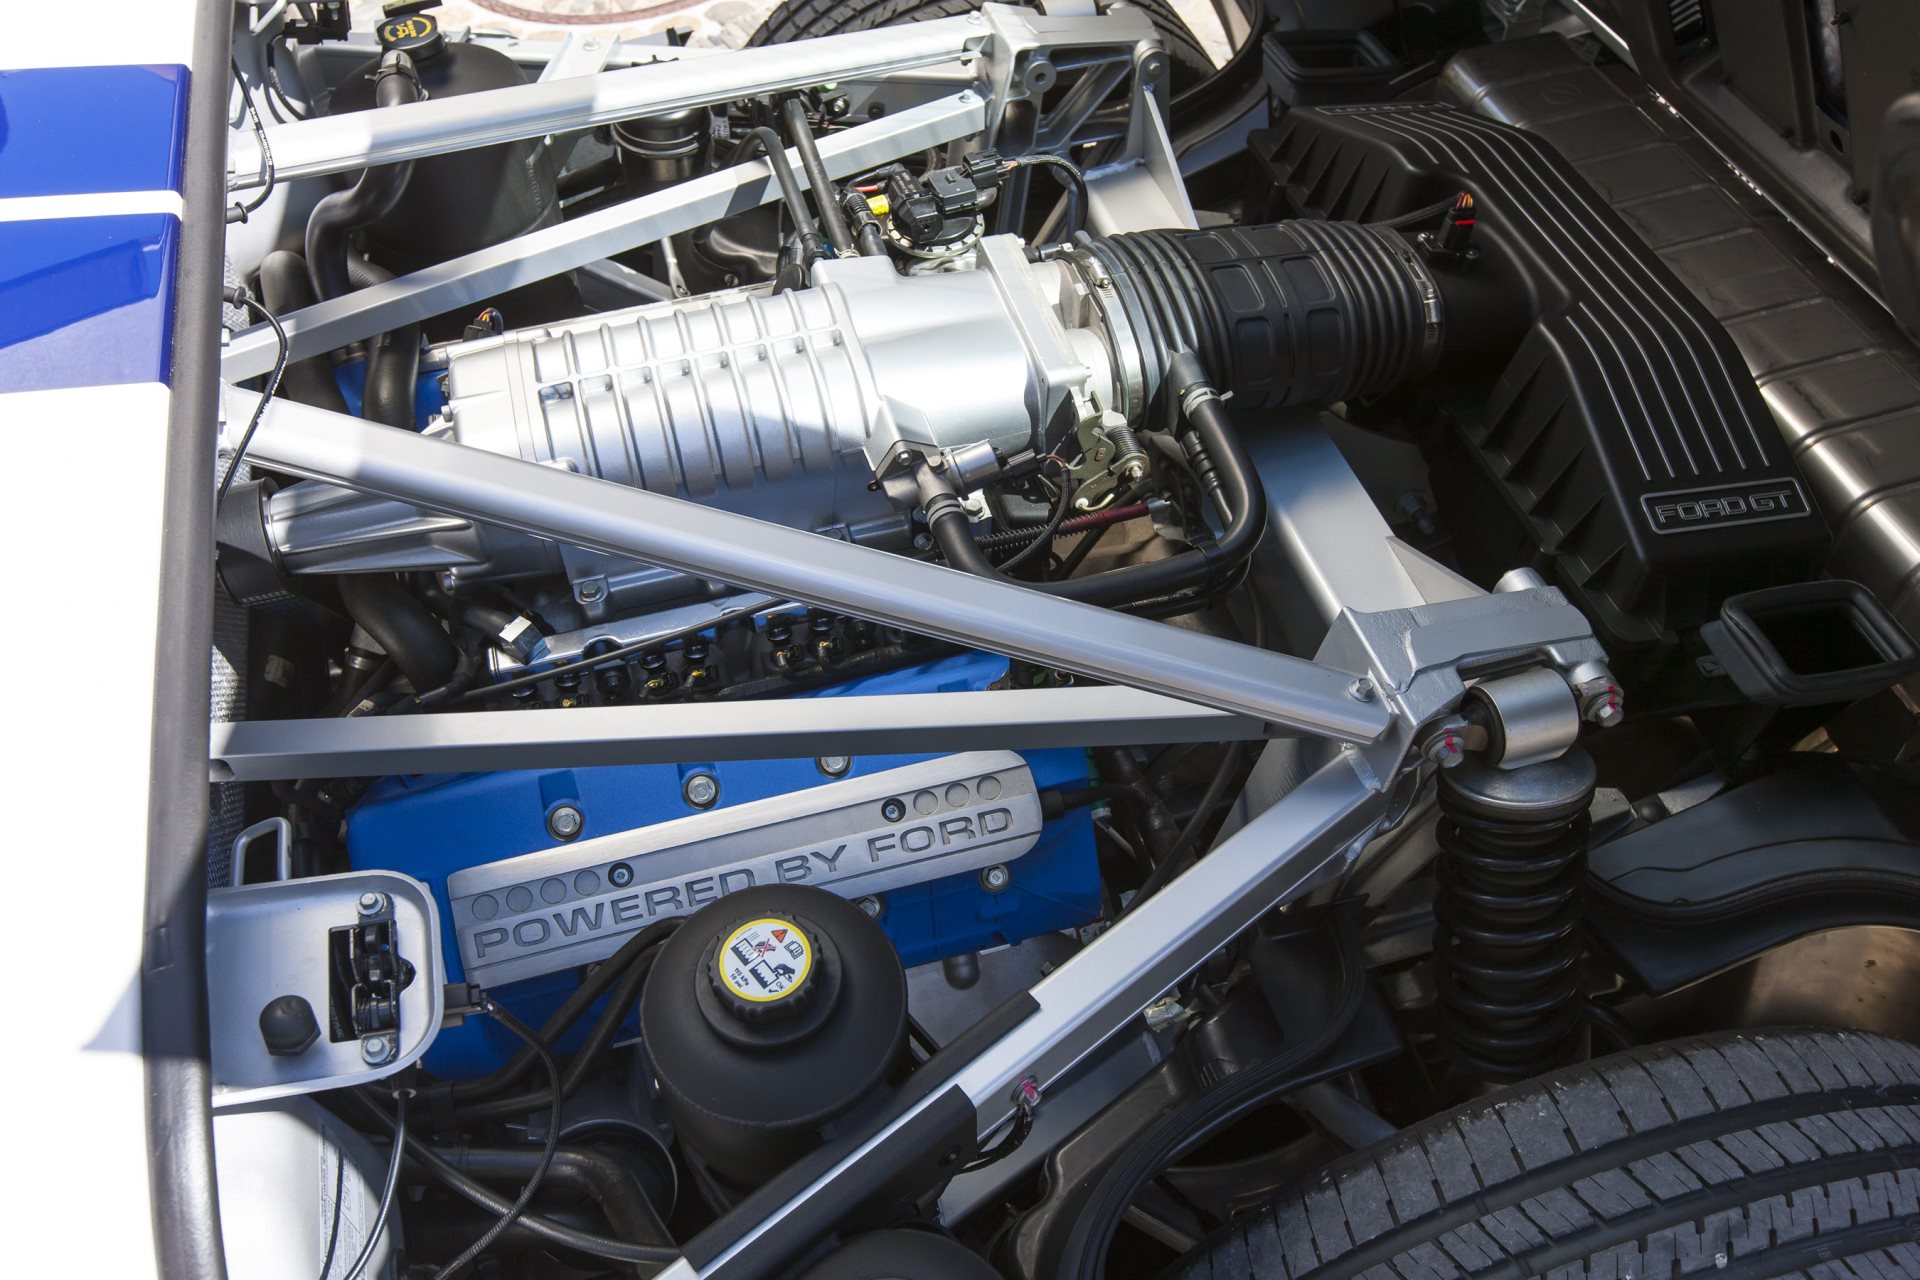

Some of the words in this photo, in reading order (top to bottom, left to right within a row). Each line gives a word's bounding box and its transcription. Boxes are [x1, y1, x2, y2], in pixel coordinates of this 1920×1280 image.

[1654, 496, 1748, 524] FORD
[1749, 489, 1792, 511] GT
[473, 868, 757, 959] POWERED
[774, 844, 848, 884] BY
[867, 807, 1014, 863] FORD
[775, 981, 785, 991] OK
